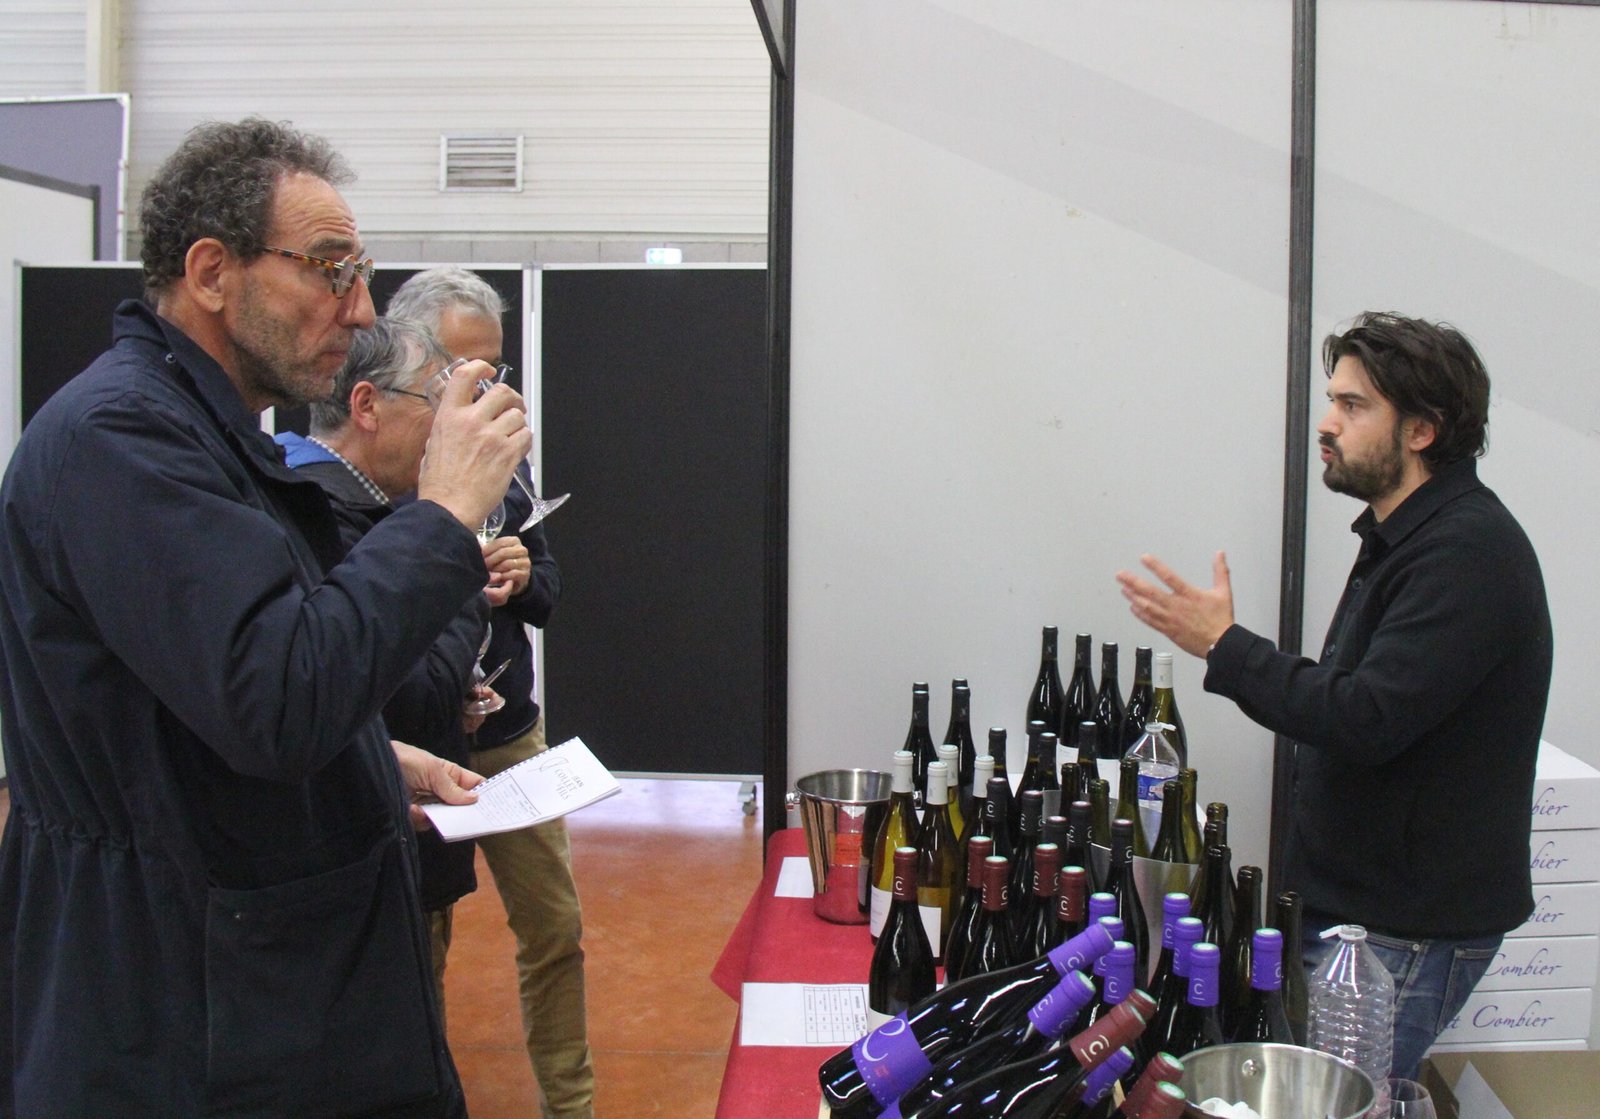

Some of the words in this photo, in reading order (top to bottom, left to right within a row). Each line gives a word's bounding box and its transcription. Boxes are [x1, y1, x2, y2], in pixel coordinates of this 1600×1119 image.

[1531, 787, 1569, 815] bier
[1531, 841, 1568, 869] bier
[1528, 895, 1565, 922] bier
[1473, 1000, 1554, 1028] Combier
